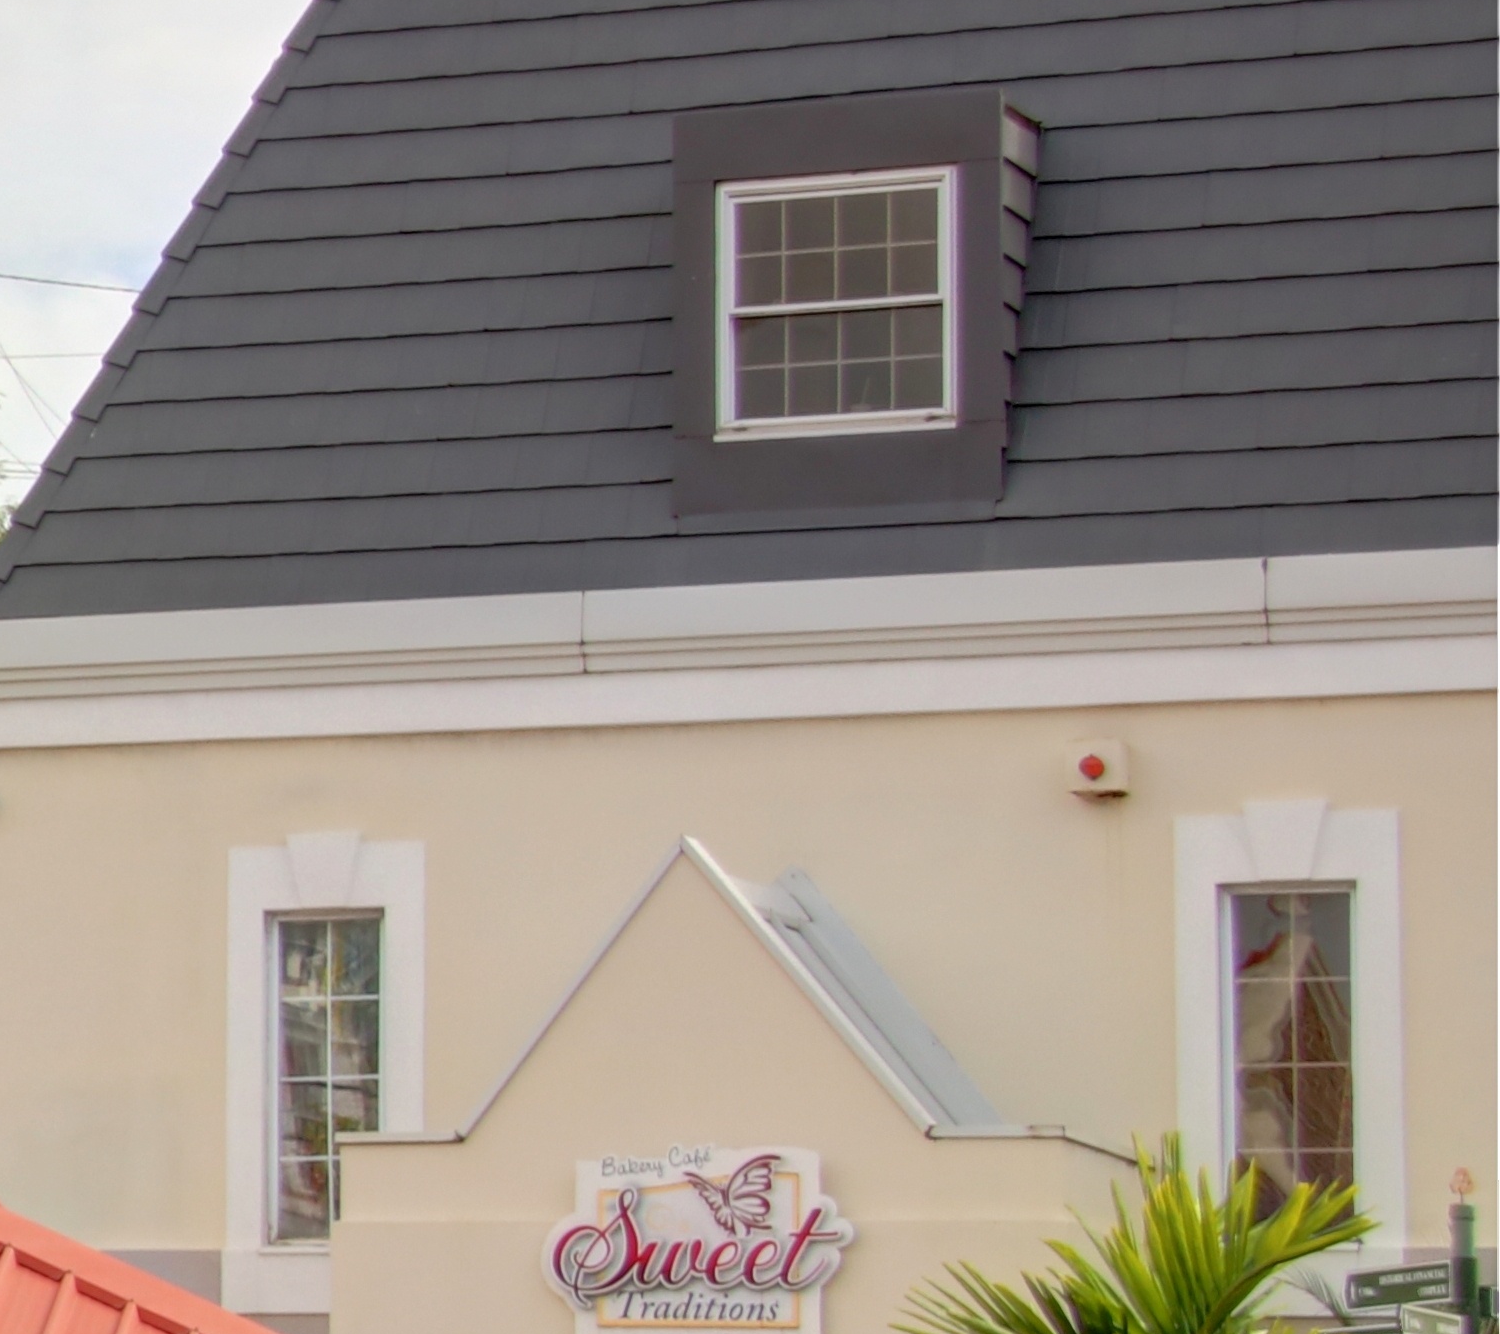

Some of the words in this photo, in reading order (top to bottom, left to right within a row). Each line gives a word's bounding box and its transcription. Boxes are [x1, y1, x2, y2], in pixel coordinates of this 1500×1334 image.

[601, 1155, 664, 1179] Bakery
[668, 1145, 712, 1169] Café
[552, 1187, 839, 1308] Sweet
[615, 1290, 781, 1322] Traditions
